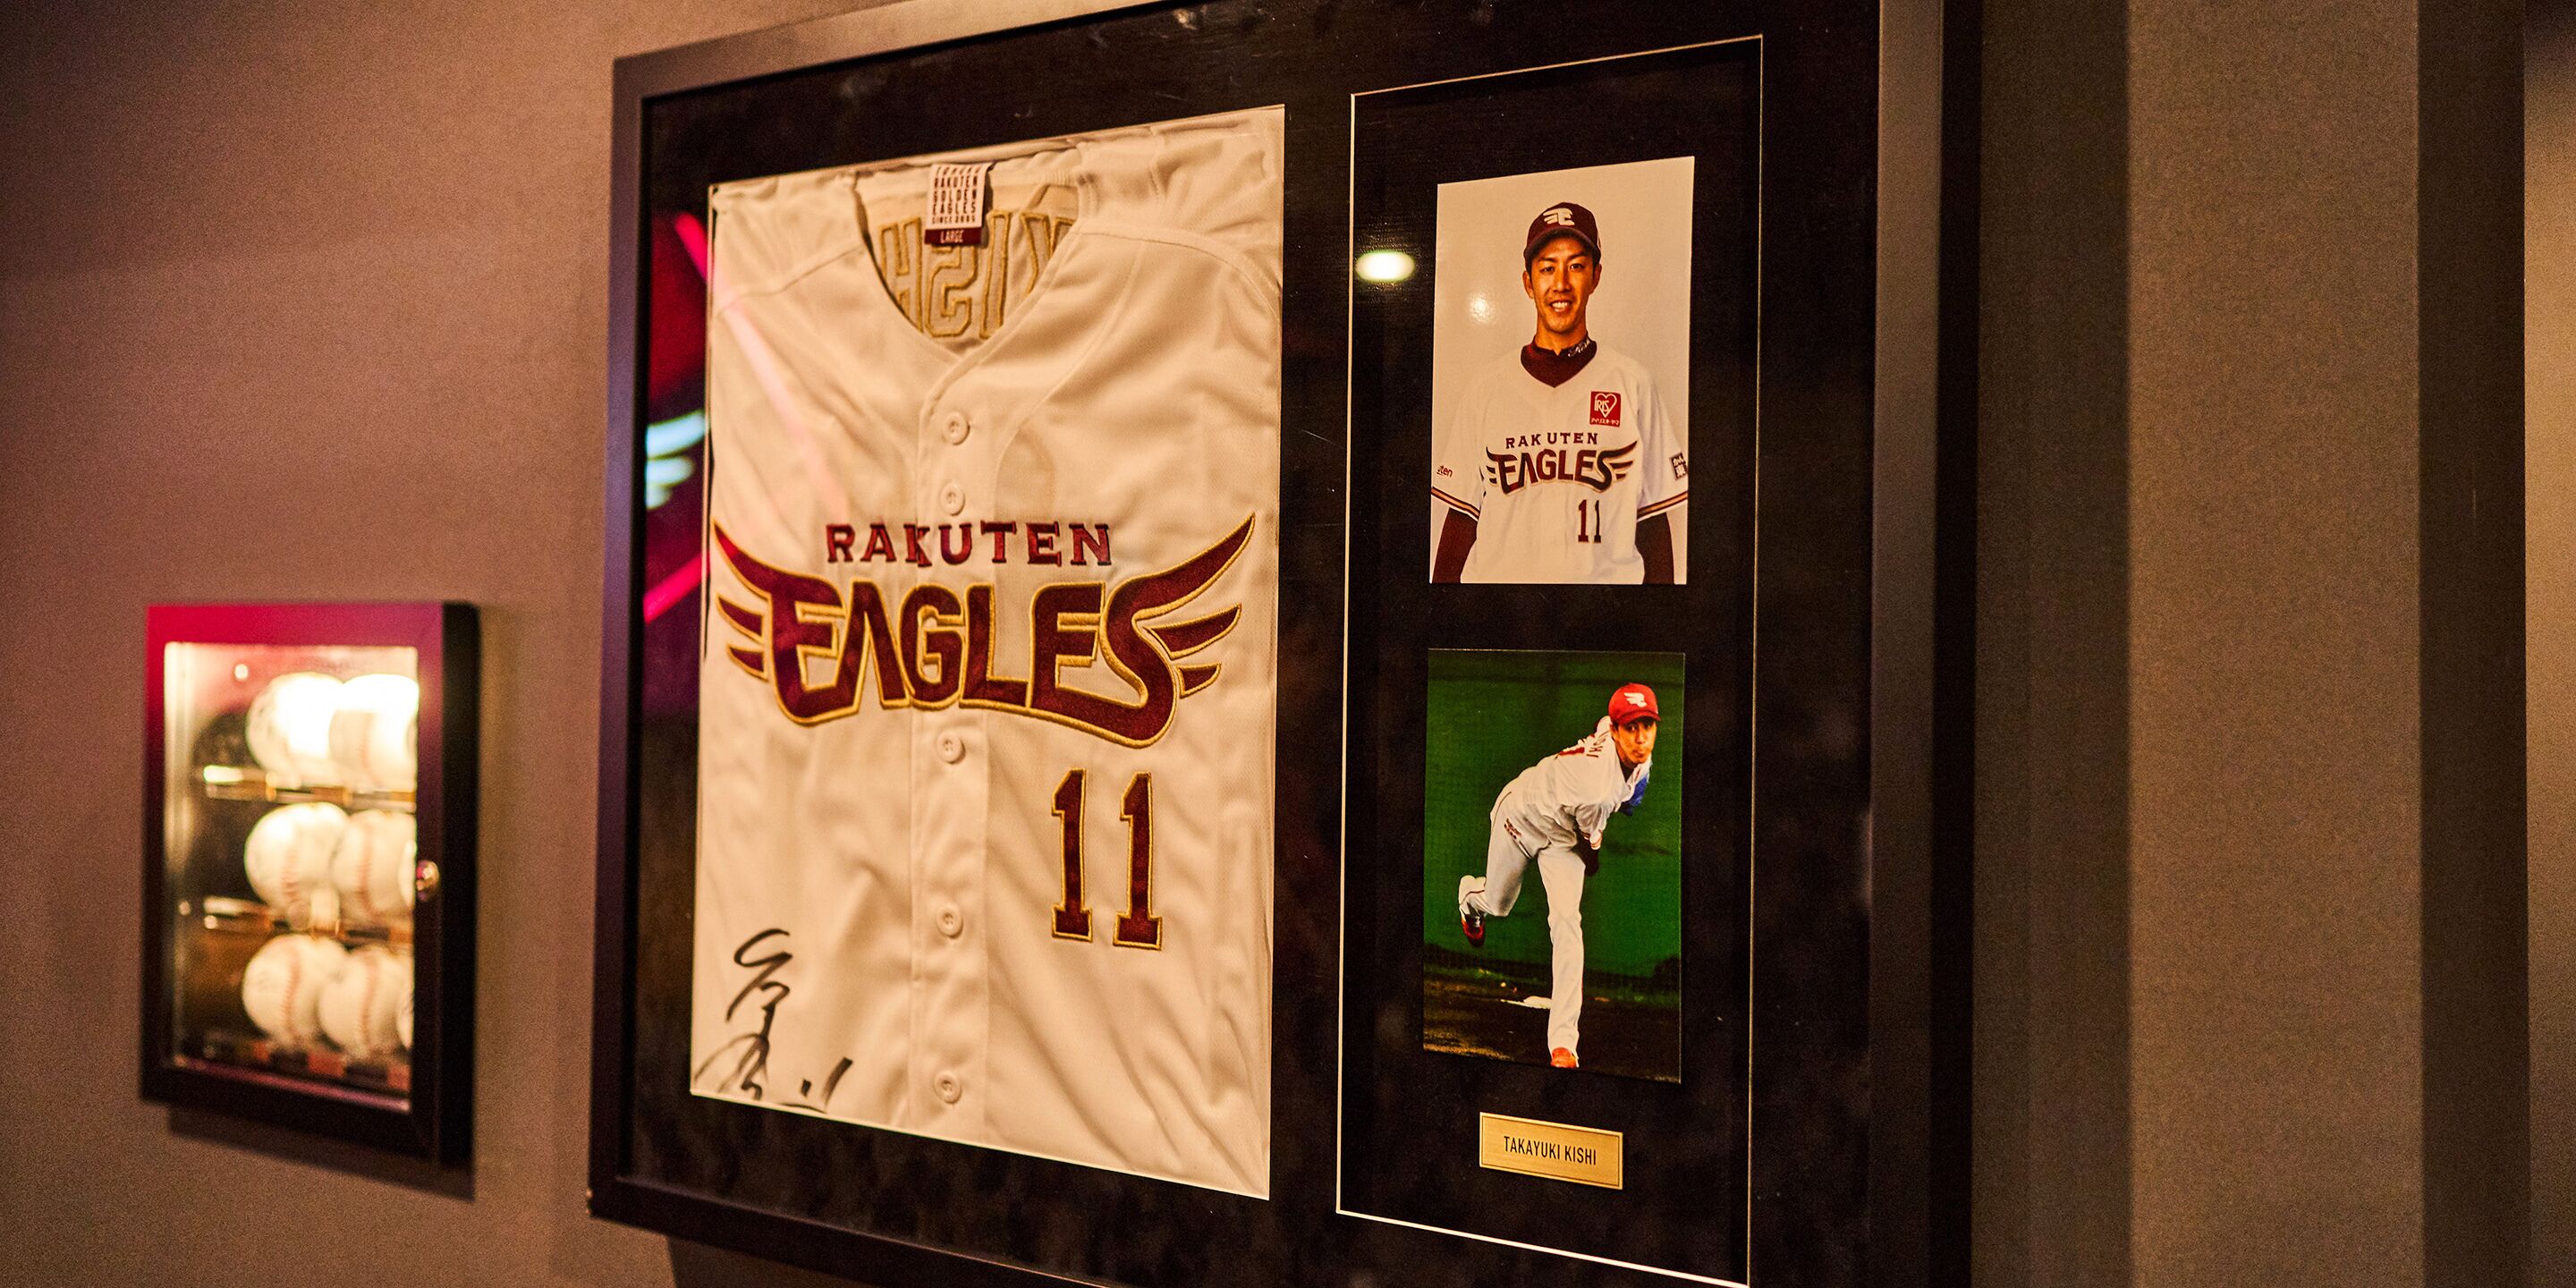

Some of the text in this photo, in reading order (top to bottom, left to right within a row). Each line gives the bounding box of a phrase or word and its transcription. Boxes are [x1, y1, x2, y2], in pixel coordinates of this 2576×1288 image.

[940, 229, 964, 244] LARGE
[1505, 432, 1598, 449] RAKUTEN
[1486, 441, 1637, 494] EAGLES
[1578, 499, 1602, 543] 11
[826, 521, 1112, 568] RAKUTEN
[715, 513, 1255, 749] EAGLES
[1052, 767, 1162, 950] 11
[1504, 1135, 1597, 1165] TAKAYUKI KISHI
